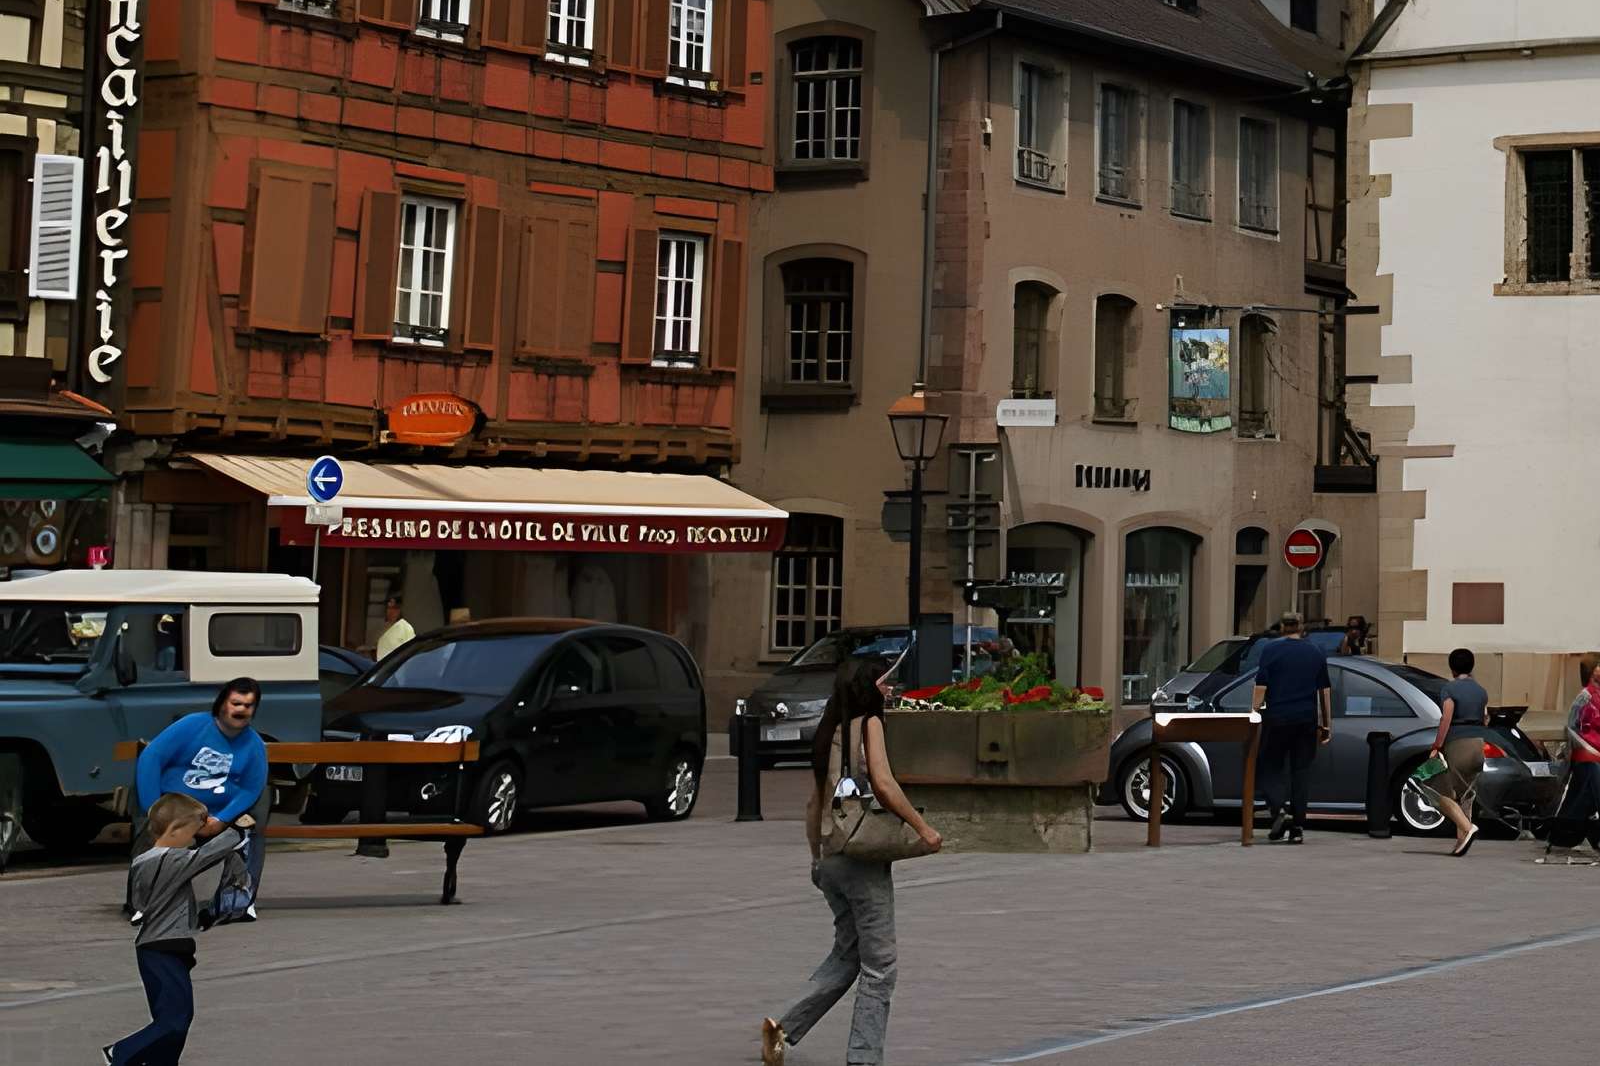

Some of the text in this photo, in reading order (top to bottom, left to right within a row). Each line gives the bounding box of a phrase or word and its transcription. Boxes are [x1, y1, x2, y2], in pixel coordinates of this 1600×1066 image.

[437, 520, 463, 540] DE
[552, 522, 576, 542] DE
[580, 523, 630, 543] VILLE
